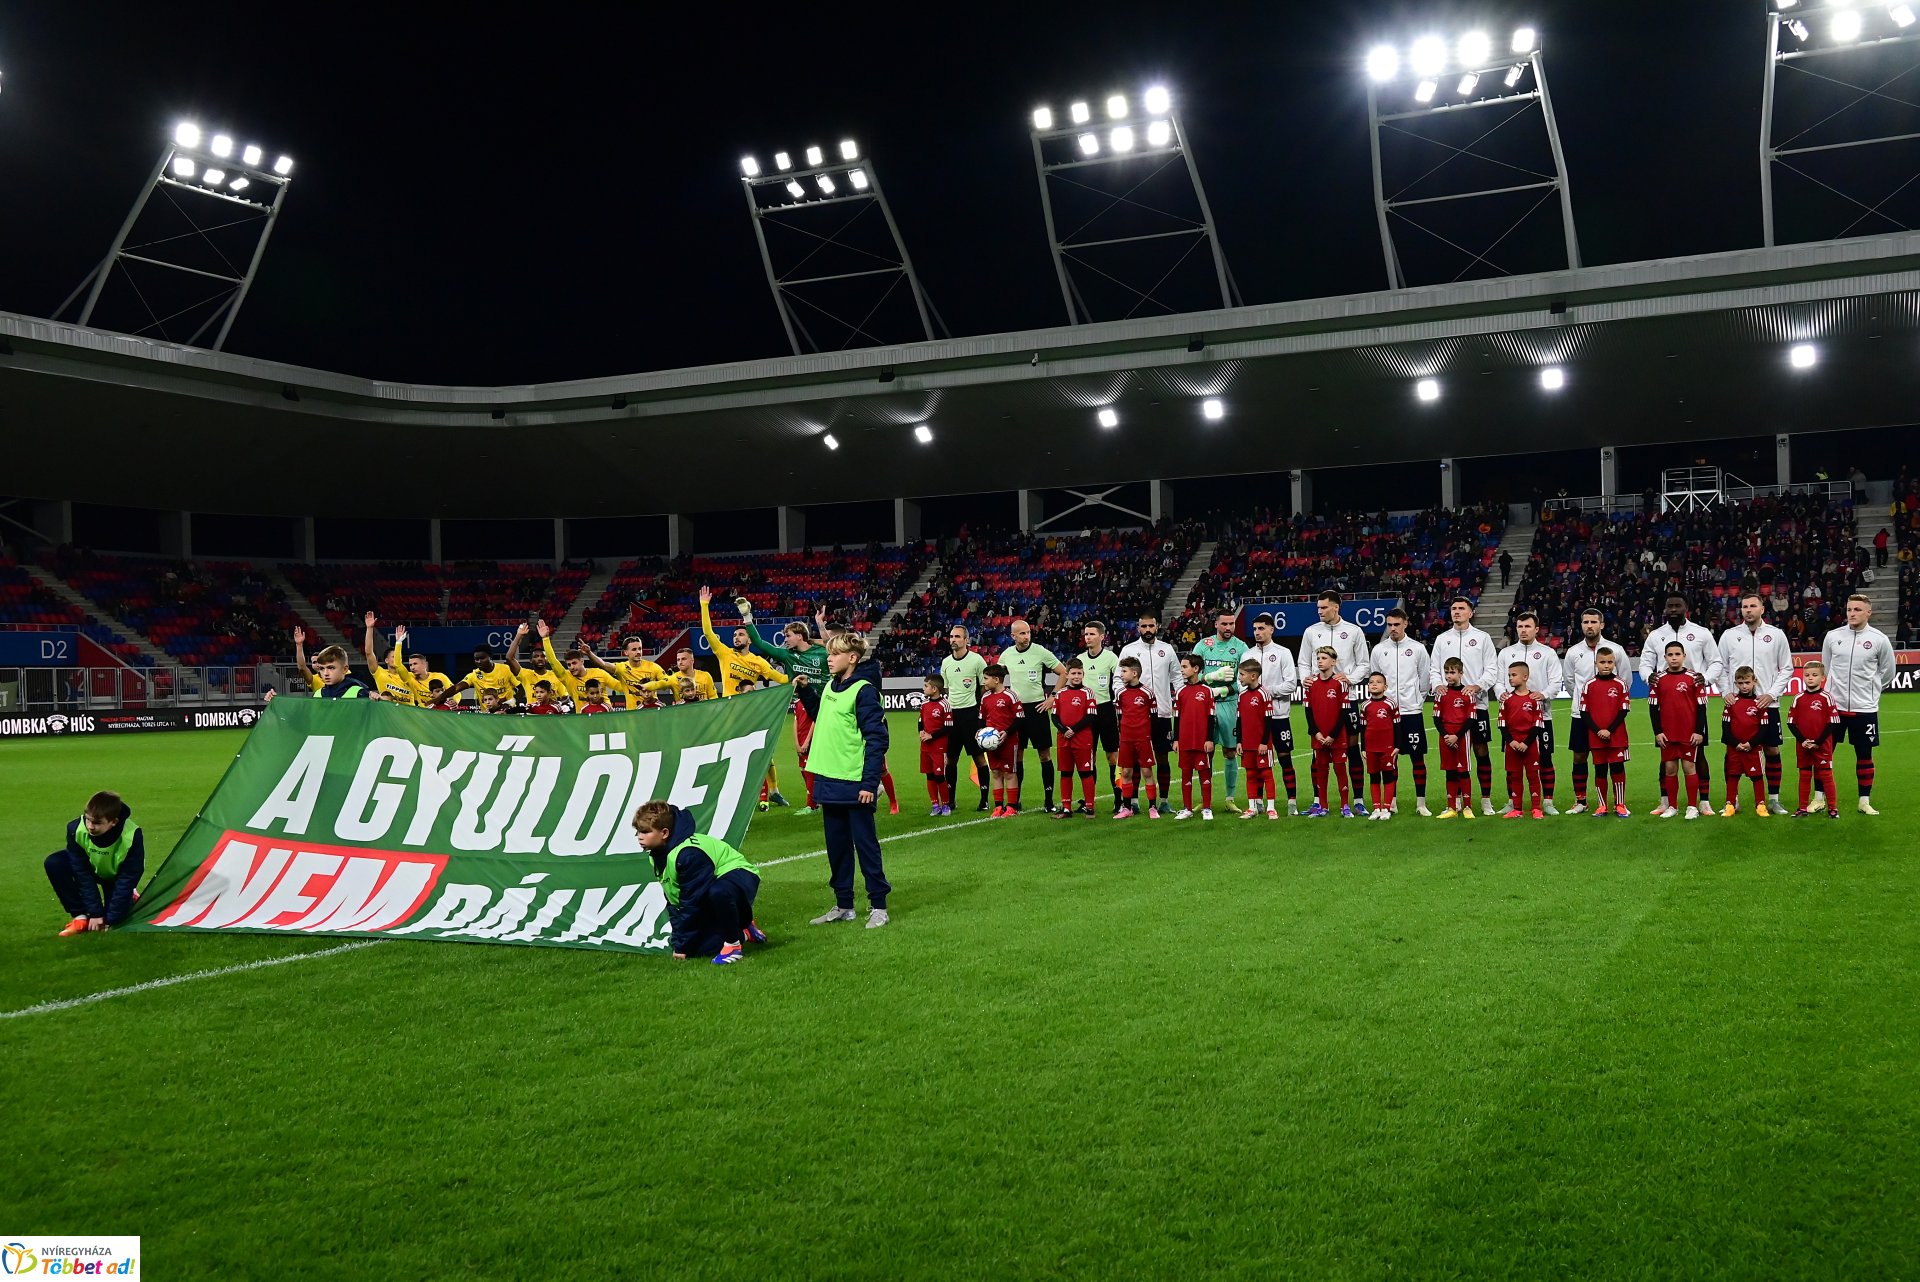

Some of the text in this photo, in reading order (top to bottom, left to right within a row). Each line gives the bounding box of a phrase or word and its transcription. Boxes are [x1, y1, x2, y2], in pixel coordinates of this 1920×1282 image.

[1355, 607, 1386, 627] C5
[487, 631, 514, 648] C8
[41, 640, 68, 660] D2
[0, 718, 47, 735] OMBKA
[70, 714, 95, 732] HÚS
[195, 712, 239, 728] DOMBKA
[1478, 721, 1487, 732] 31
[1280, 730, 1291, 741] 88
[1542, 732, 1549, 742] 6
[1865, 723, 1876, 735] 21
[1408, 732, 1420, 744] 55
[246, 734, 334, 833] A
[153, 839, 437, 932] NEM
